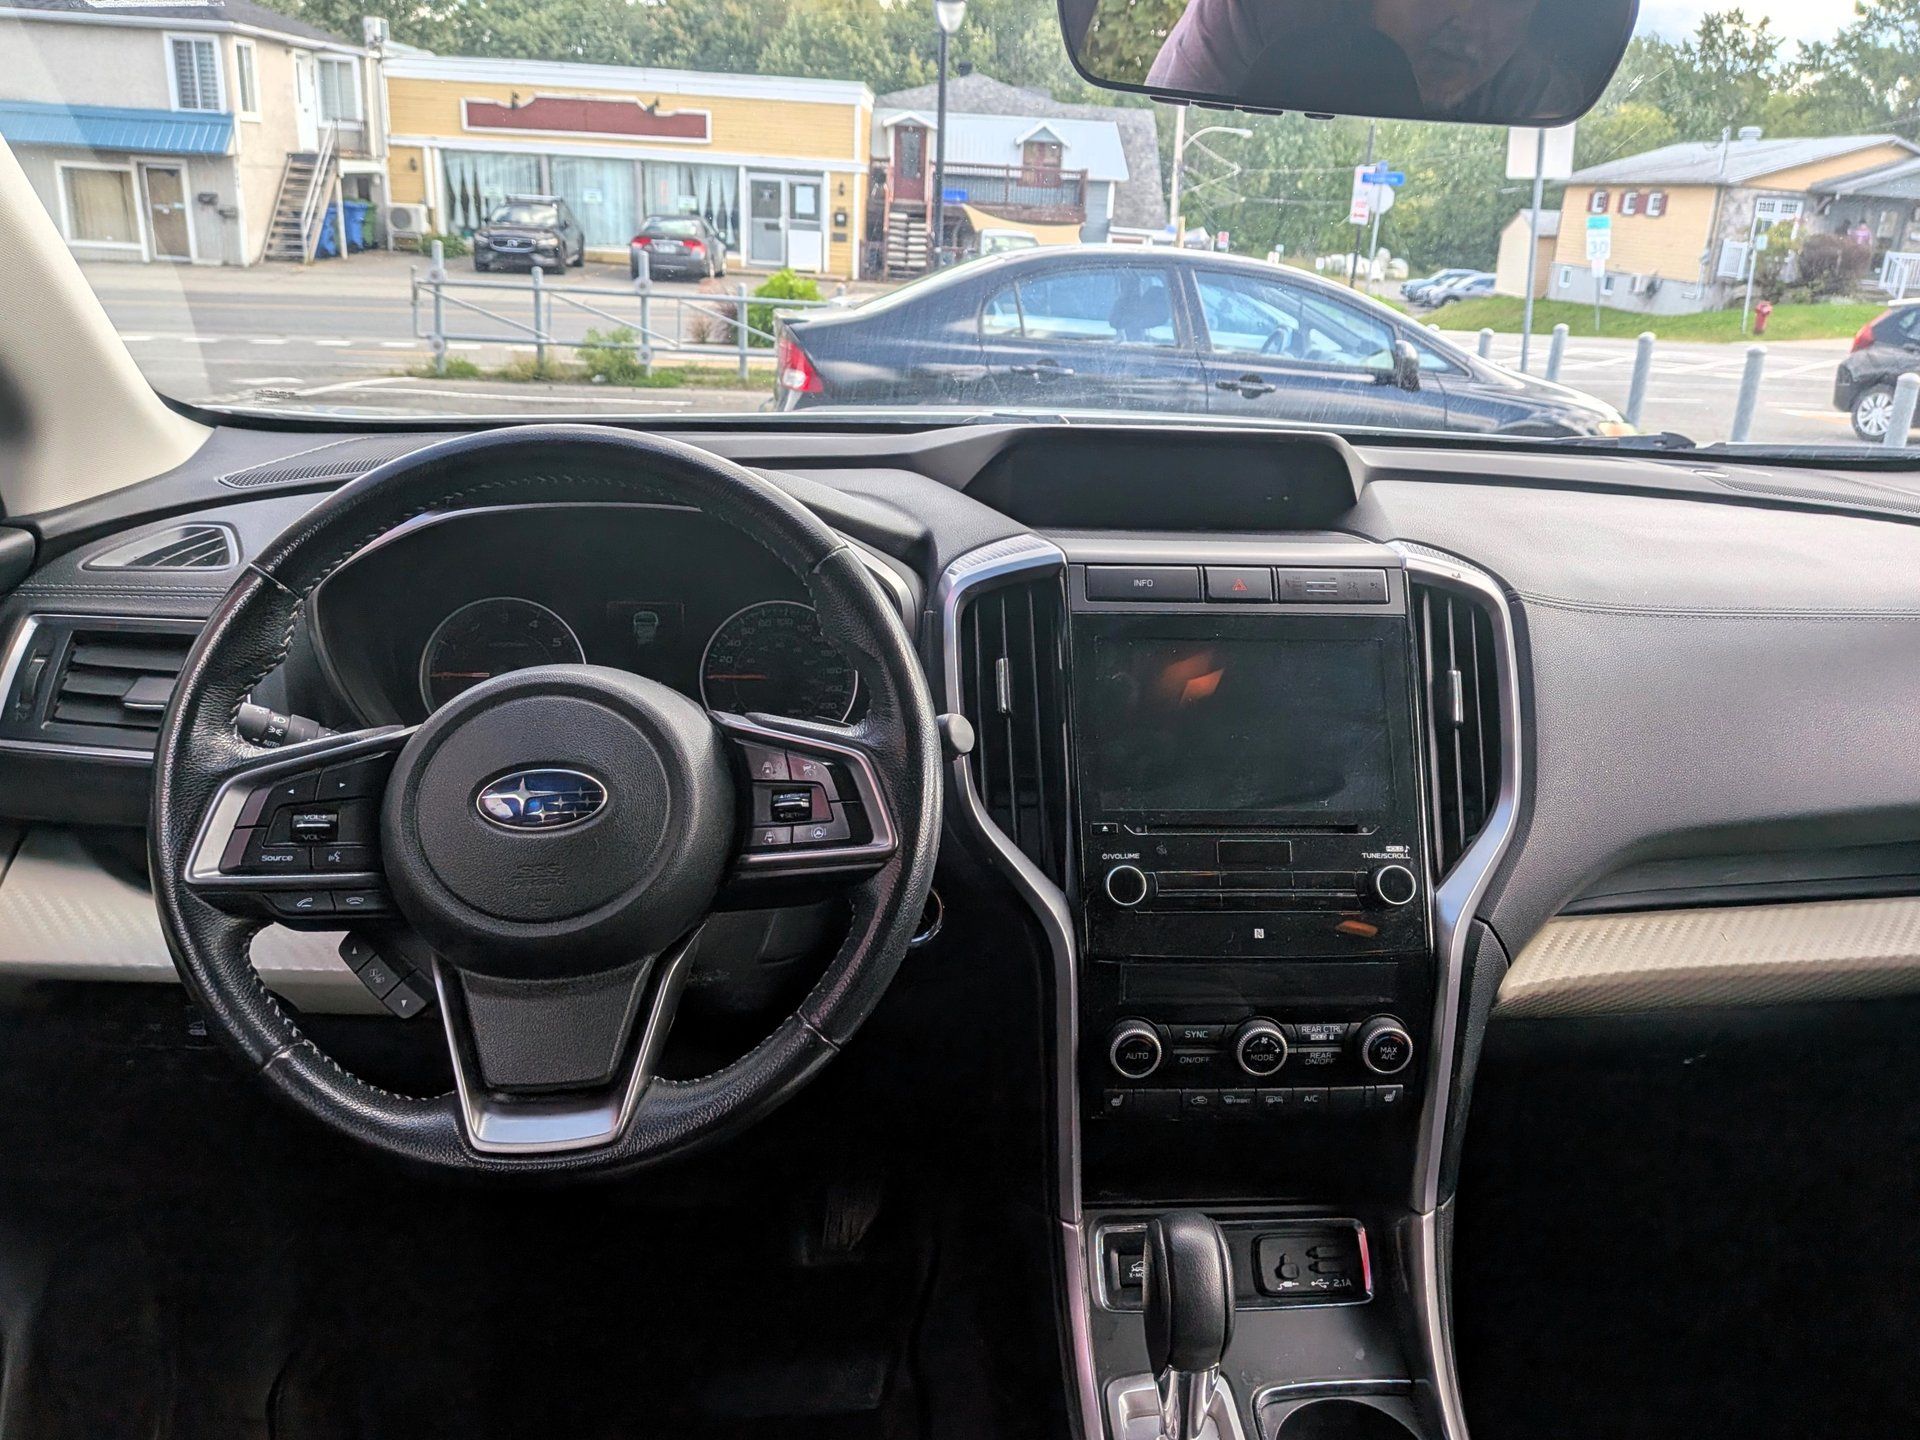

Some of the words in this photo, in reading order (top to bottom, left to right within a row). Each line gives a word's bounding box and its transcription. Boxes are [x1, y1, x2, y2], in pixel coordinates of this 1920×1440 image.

[1133, 579, 1154, 587] INFO
[529, 619, 540, 629] 4
[551, 637, 563, 648] 5
[718, 655, 734, 665] 20
[263, 739, 281, 749] AUTO
[261, 854, 294, 862] Source
[1361, 852, 1412, 860] TUNE/SCROLL
[1301, 1025, 1322, 1033] REAR
[1323, 1025, 1343, 1033] CTRL
[1184, 1030, 1209, 1039] SYNC
[1125, 1052, 1150, 1060] AUTO
[1179, 1056, 1211, 1064] ON/OFF
[1250, 1053, 1275, 1062] MODE
[1304, 1058, 1336, 1066] ON/OFF
[1303, 1095, 1319, 1103] A/C
[1333, 1278, 1353, 1287] 2.1A
